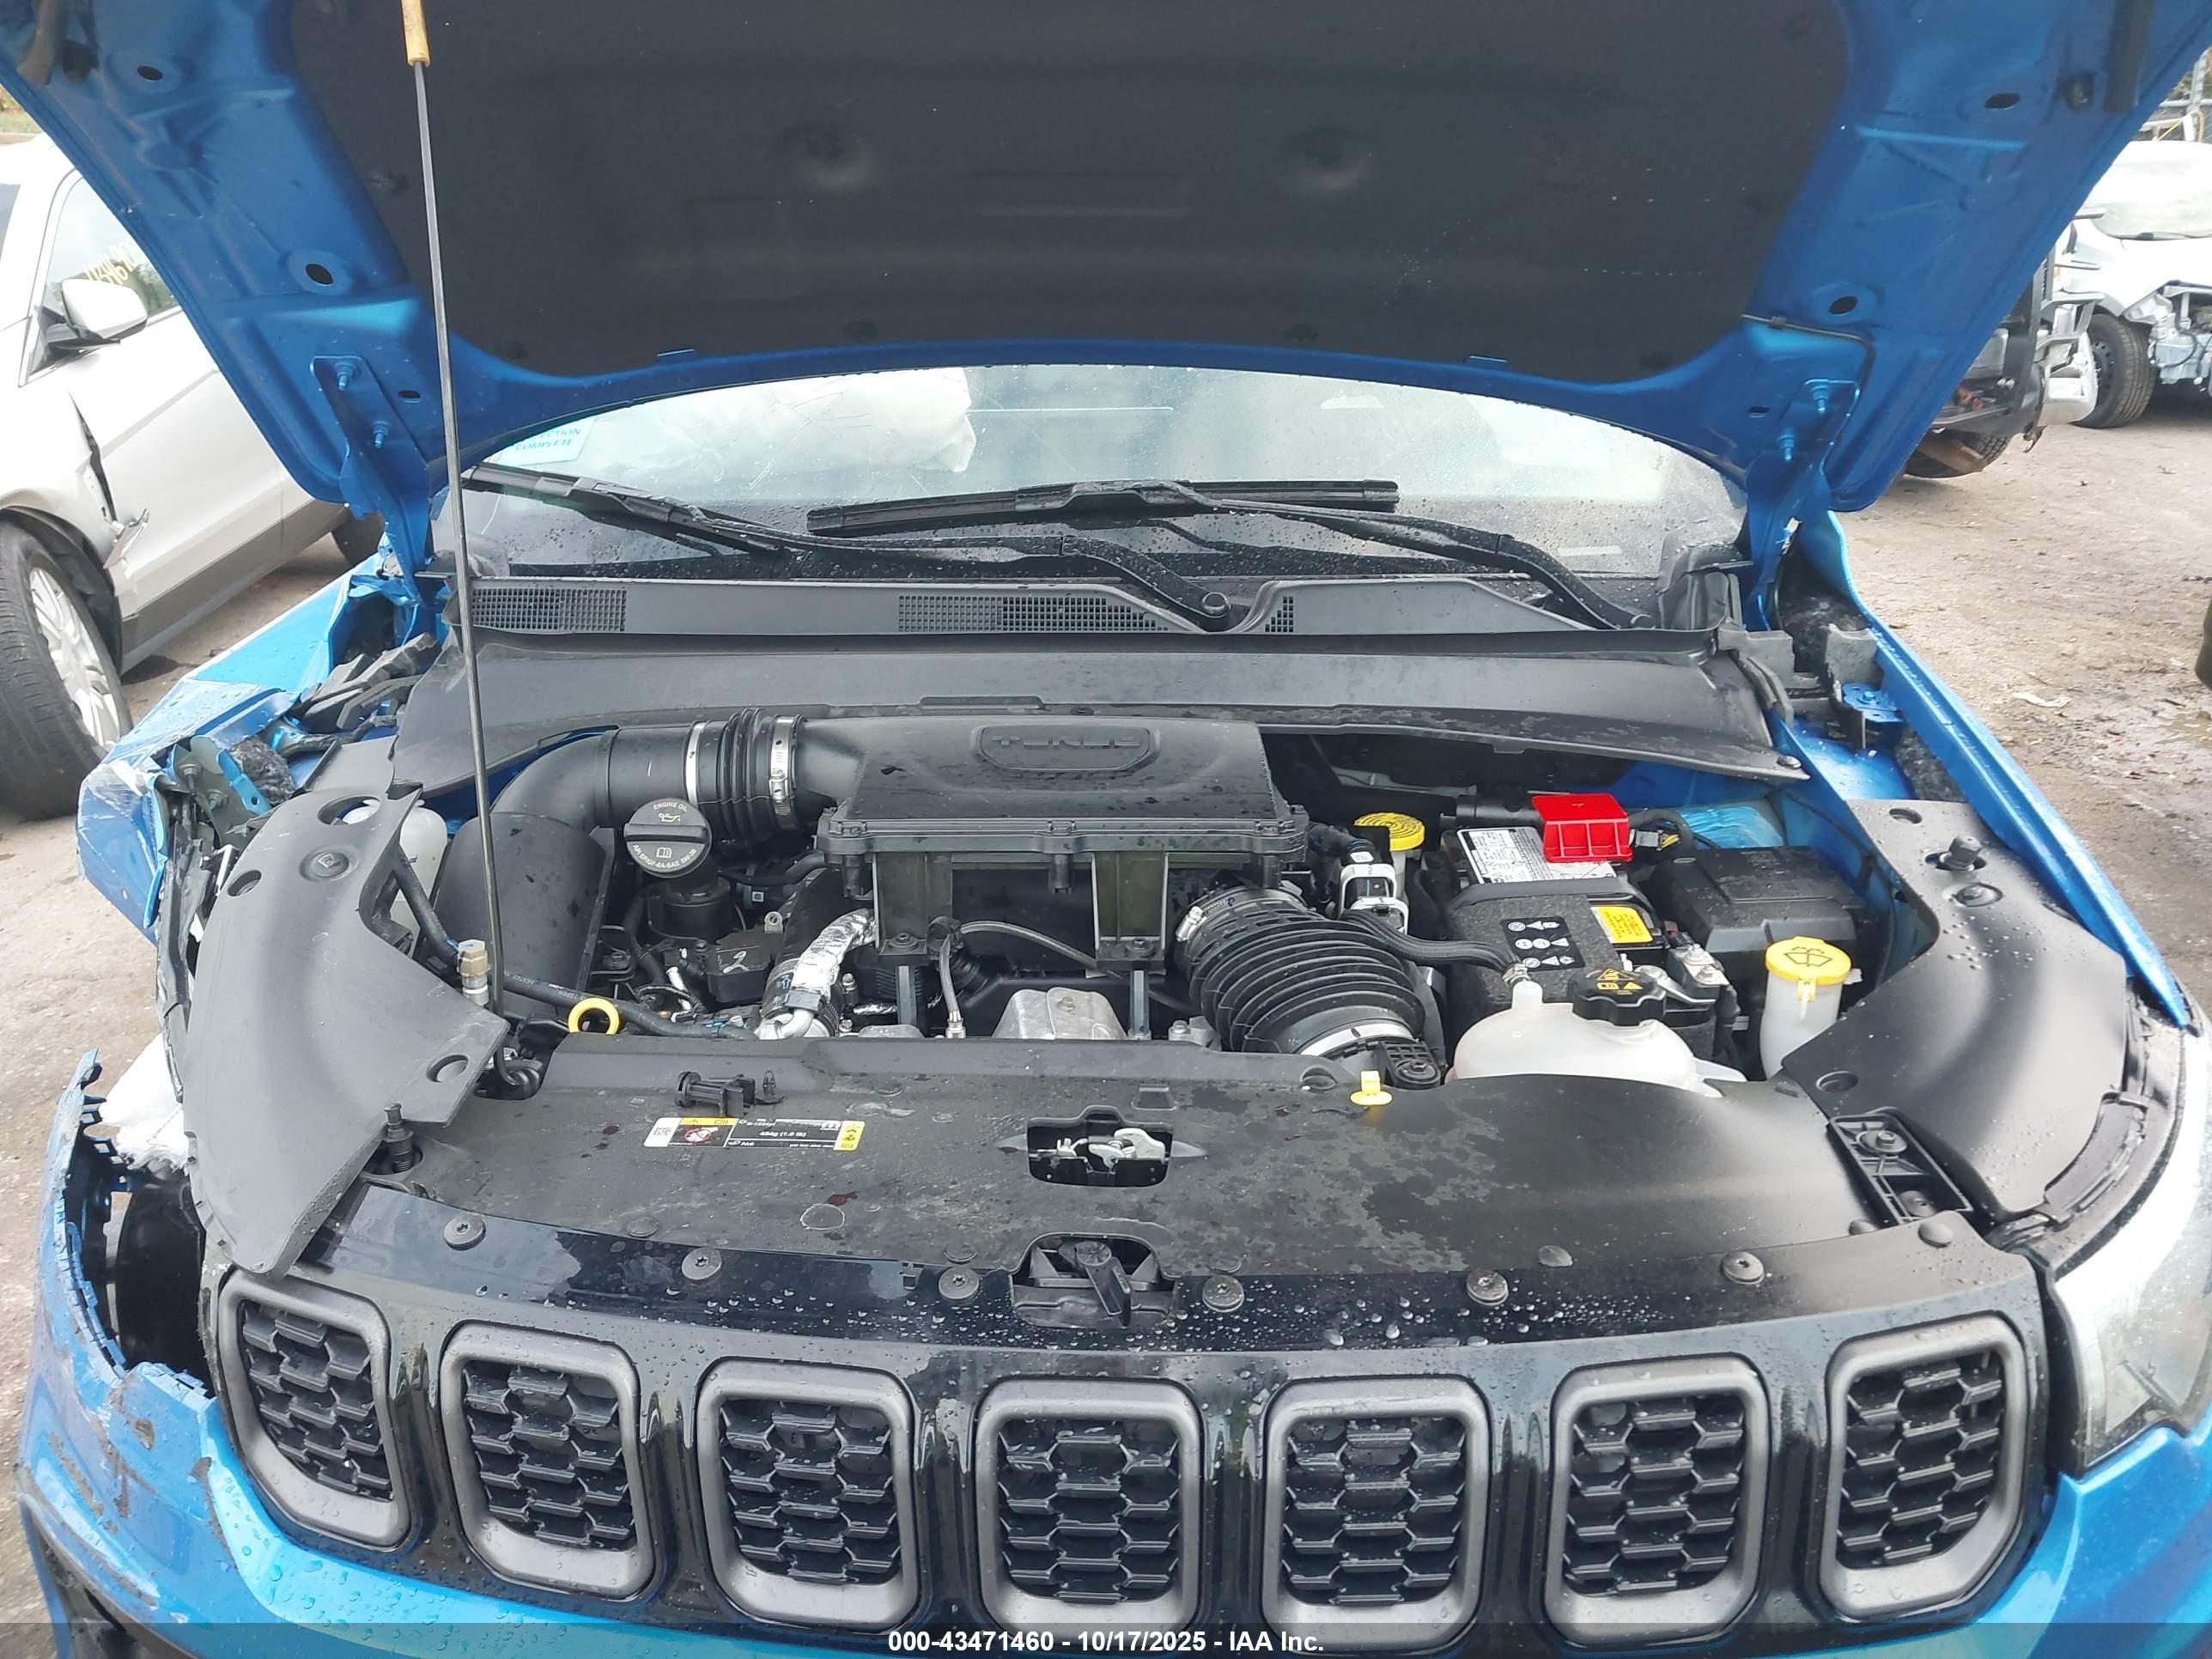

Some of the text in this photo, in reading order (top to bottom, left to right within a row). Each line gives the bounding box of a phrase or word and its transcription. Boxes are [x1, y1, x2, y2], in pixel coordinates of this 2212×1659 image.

[515, 439, 572, 451] COMPLETE
[653, 801, 688, 812] ENGINE OIL
